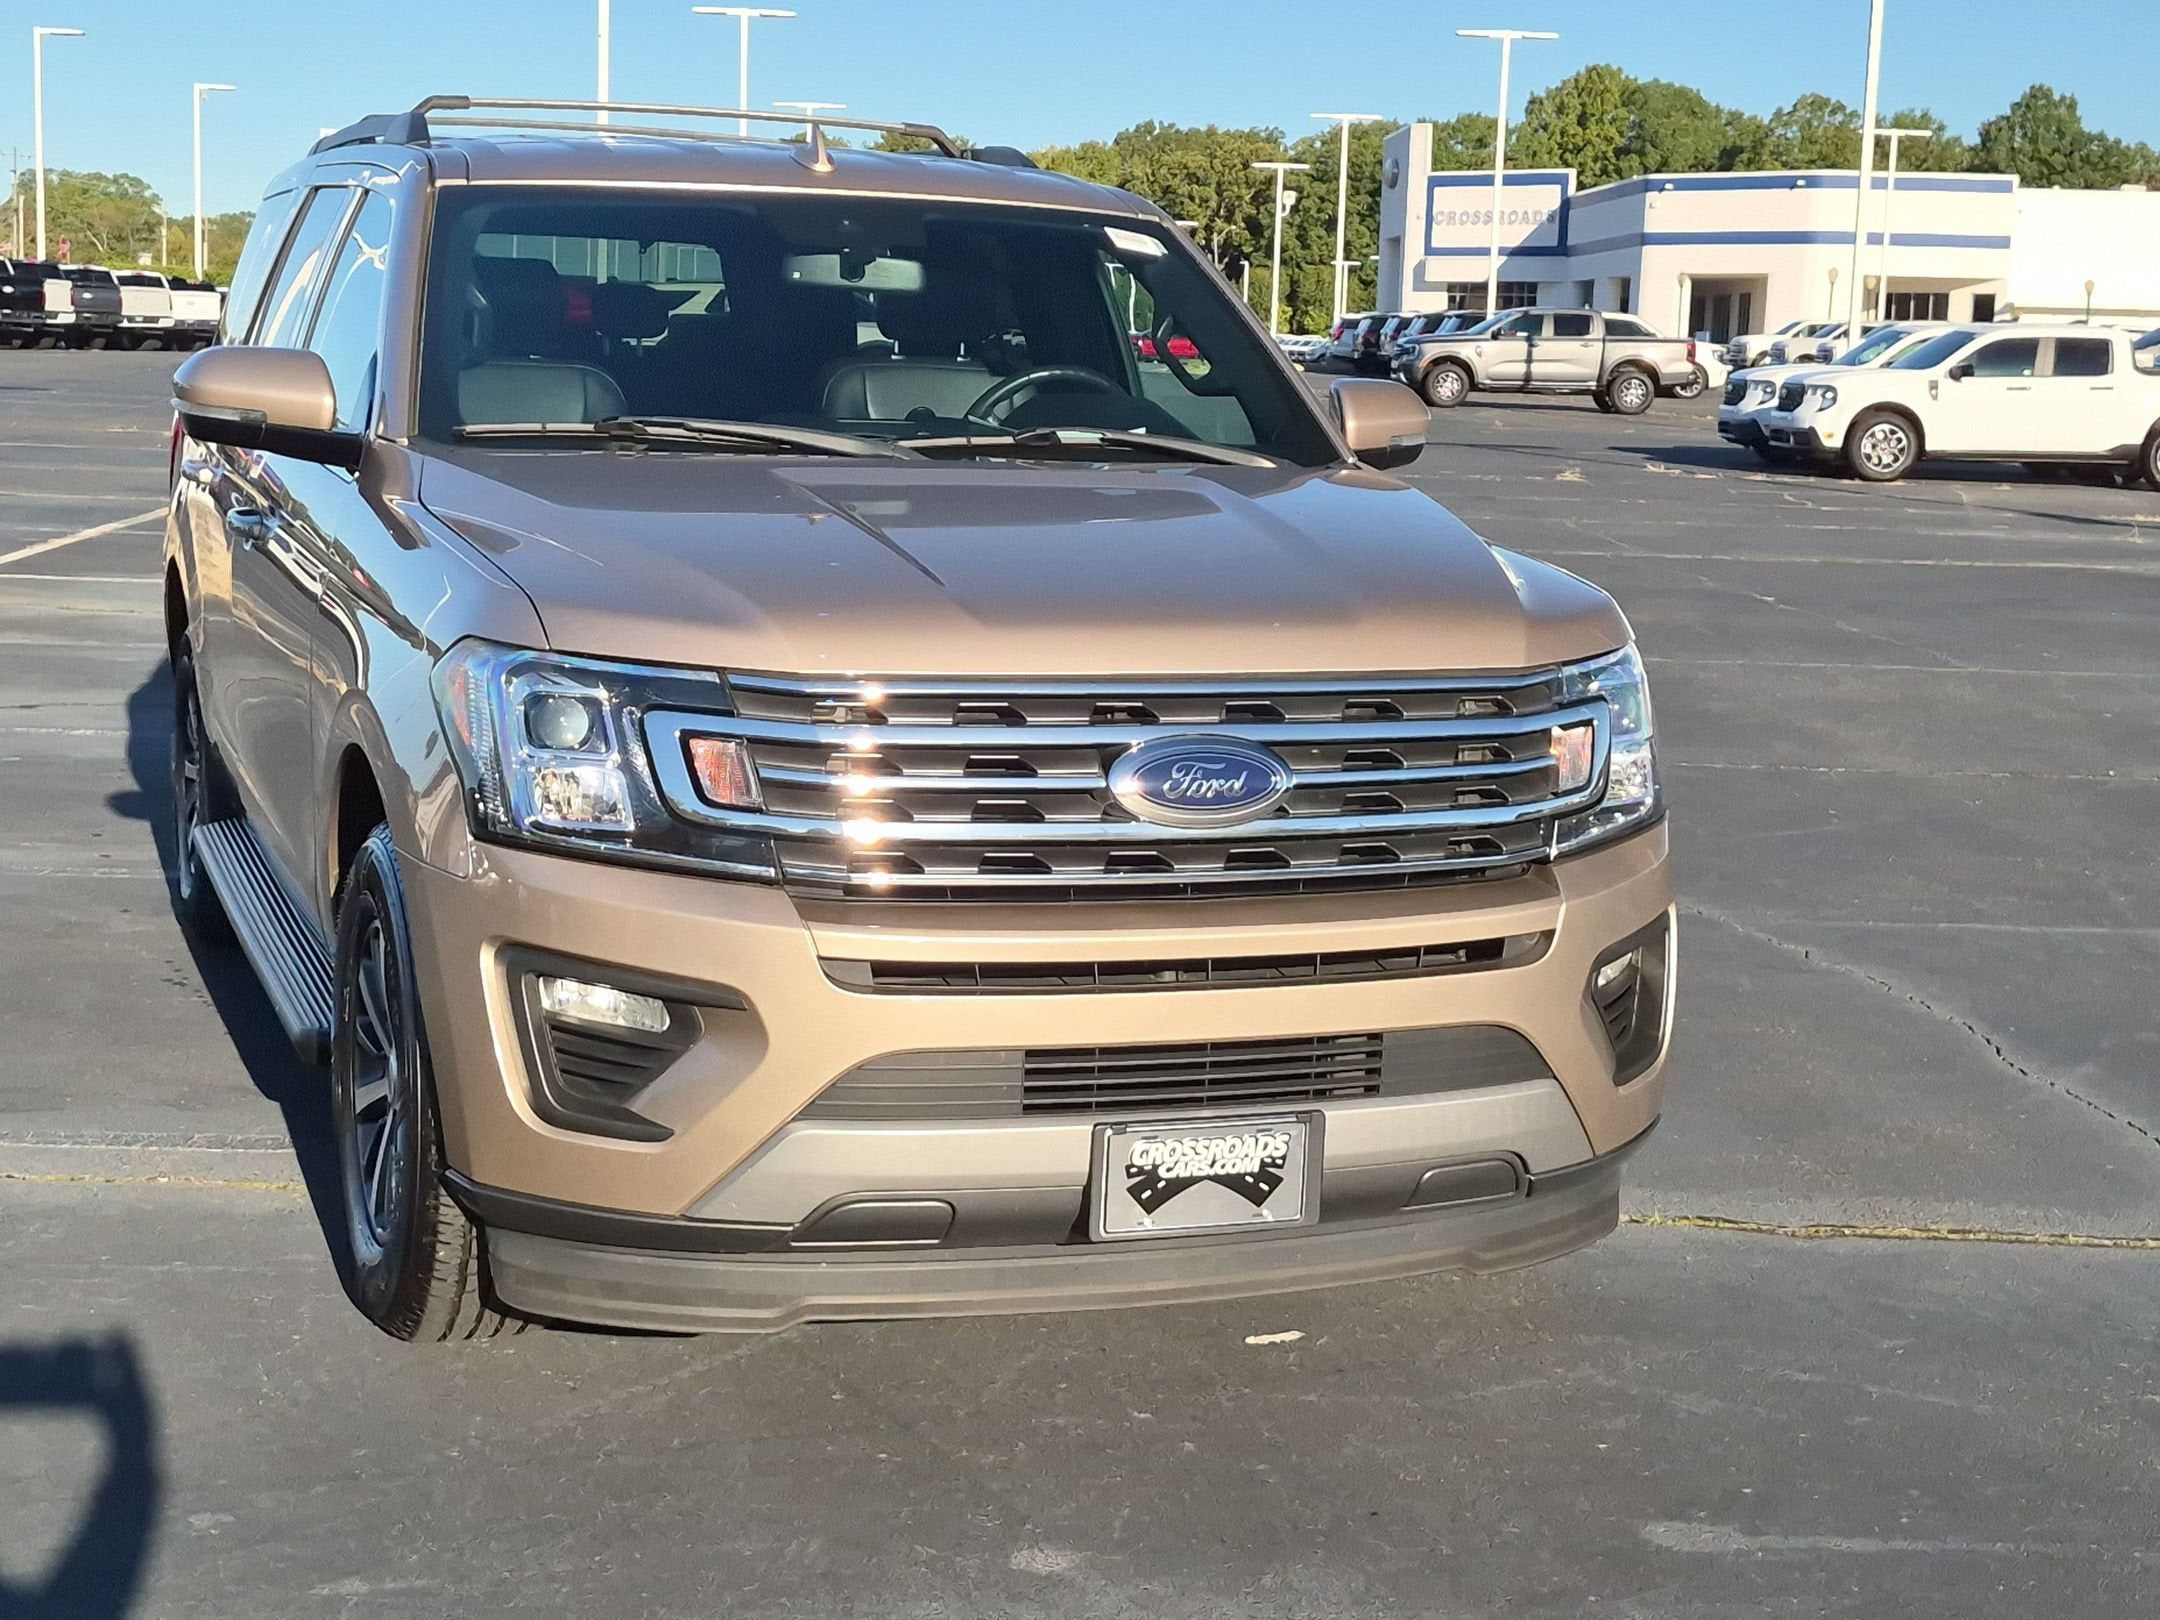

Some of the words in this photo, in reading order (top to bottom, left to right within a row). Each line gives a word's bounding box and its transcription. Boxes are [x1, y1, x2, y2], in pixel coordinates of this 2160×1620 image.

[1162, 761, 1248, 799] Ford
[1129, 1132, 1291, 1166] CROSSROADS
[1157, 1157, 1262, 1179] CARS.COM
